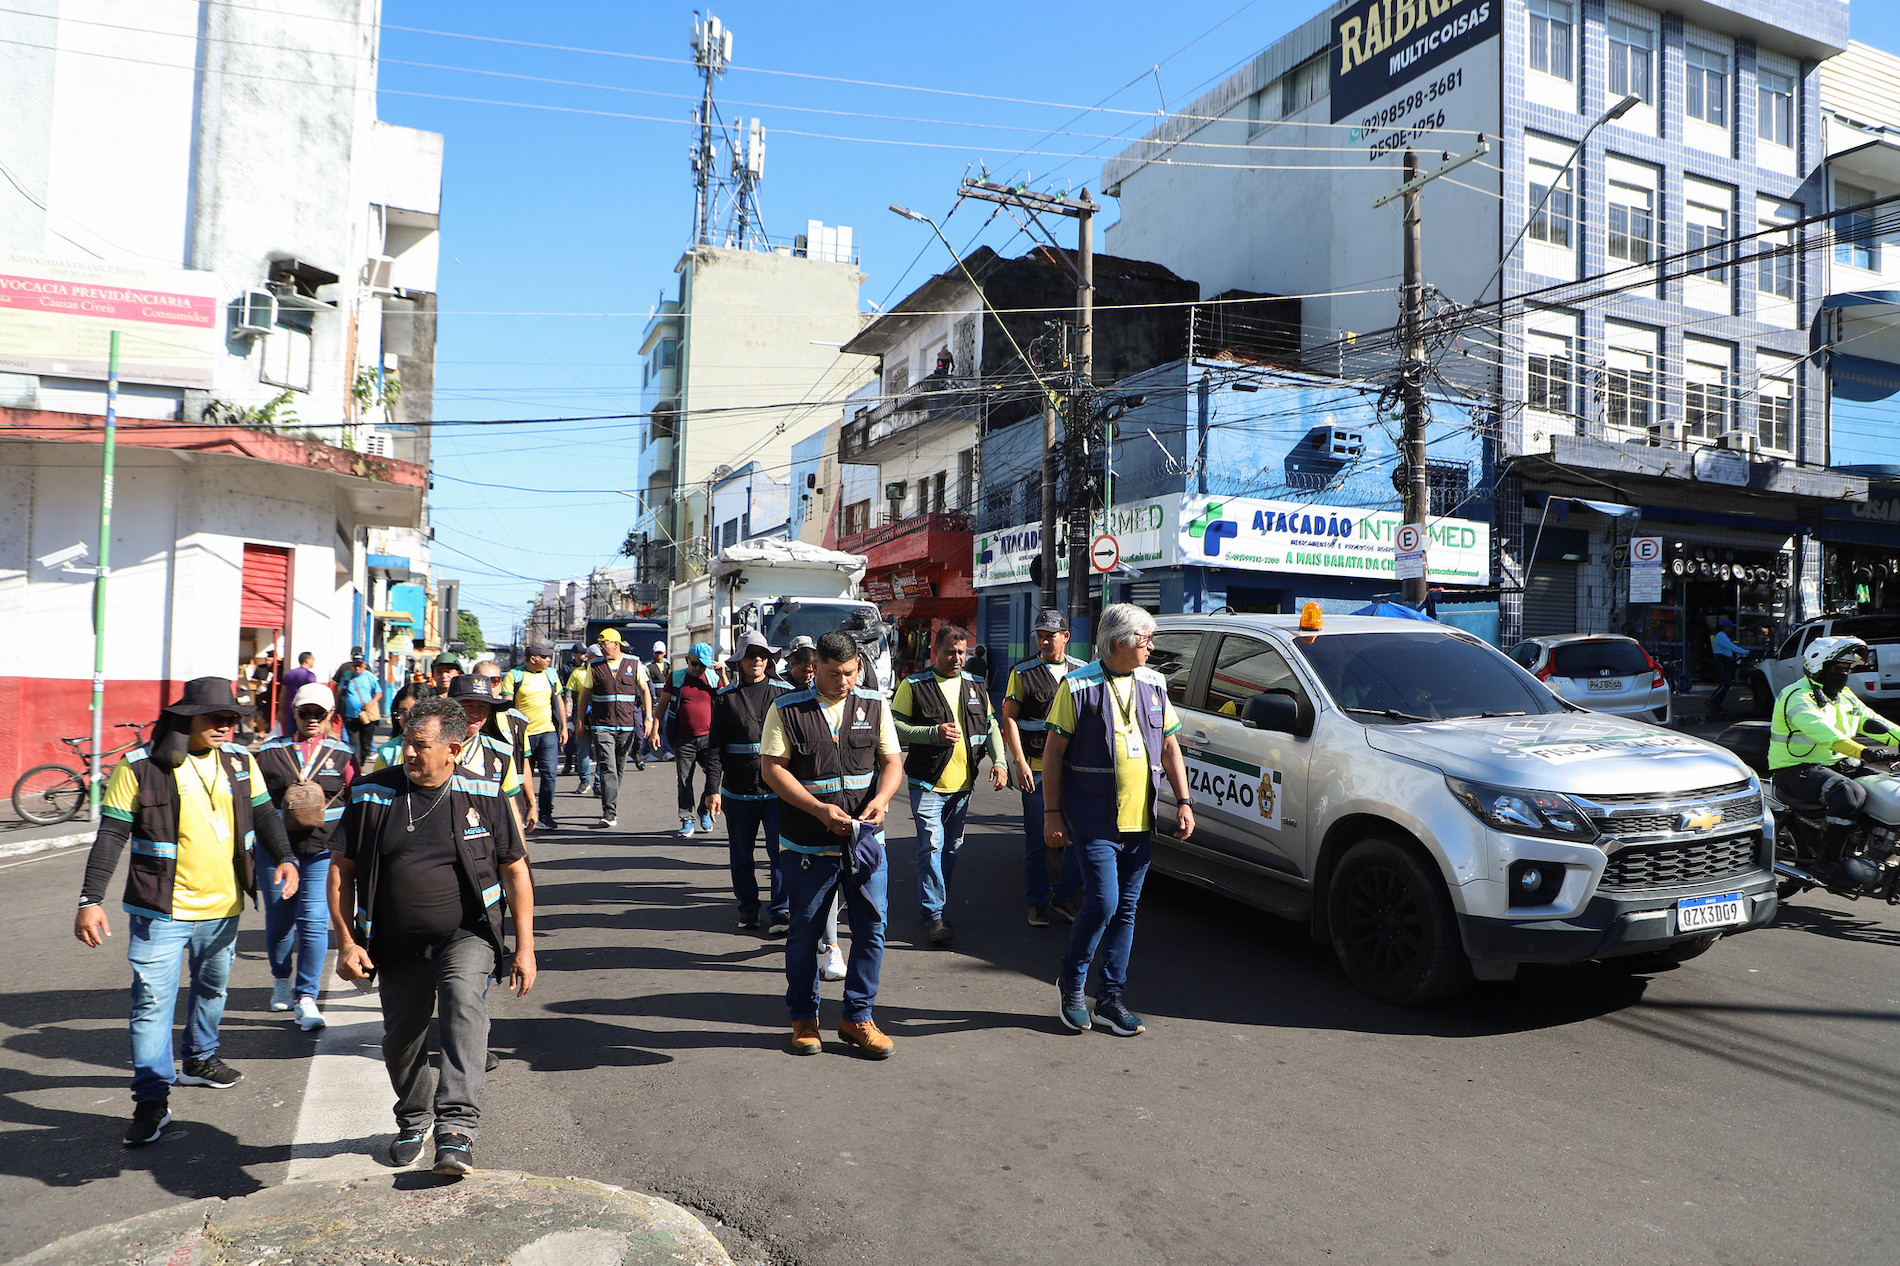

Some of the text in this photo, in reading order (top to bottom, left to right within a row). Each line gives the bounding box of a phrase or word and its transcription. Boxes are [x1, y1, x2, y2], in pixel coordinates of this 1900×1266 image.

[1389, 2, 1490, 76] MULTICOISAS
[1361, 68, 1463, 139] (92)98598-3681
[1370, 108, 1446, 161] DESDE-1956
[39, 297, 78, 310] Causas
[142, 306, 209, 323] Consumidor
[72, 286, 192, 309] PREVIDÊNCIARIA
[1000, 529, 1042, 555] ATACAD
[1252, 509, 1477, 549] ATACADÃO INTMED
[1403, 531, 1413, 547] E
[1285, 551, 1293, 564] A
[1297, 552, 1322, 565] MAIS
[1324, 554, 1365, 570] BARATA
[1366, 557, 1380, 571] DA
[1641, 543, 1652, 556] E
